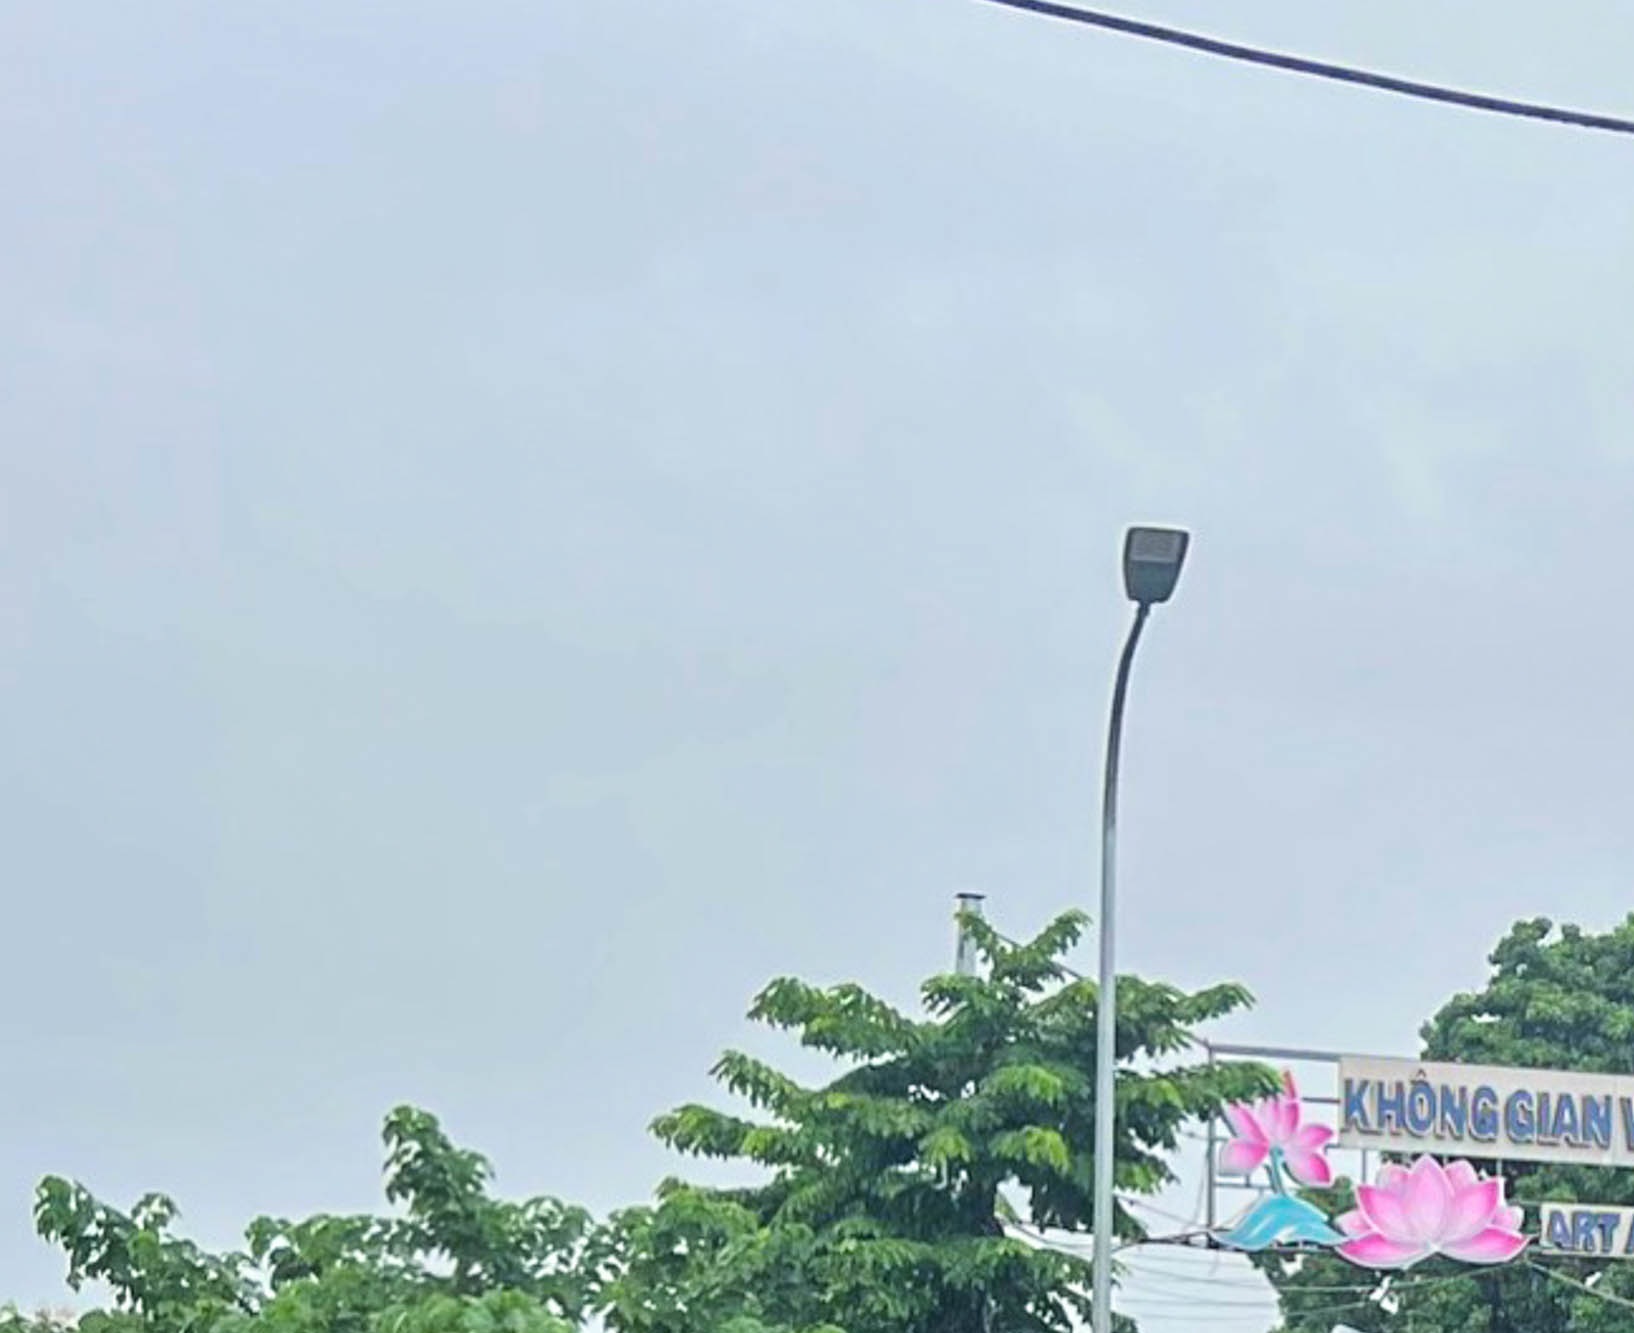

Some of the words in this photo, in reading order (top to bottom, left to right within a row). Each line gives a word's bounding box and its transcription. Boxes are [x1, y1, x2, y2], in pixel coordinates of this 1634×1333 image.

[1340, 1068, 1499, 1142] KHÔNG
[1503, 1087, 1614, 1151] GIAN
[1546, 1209, 1620, 1252] ART
